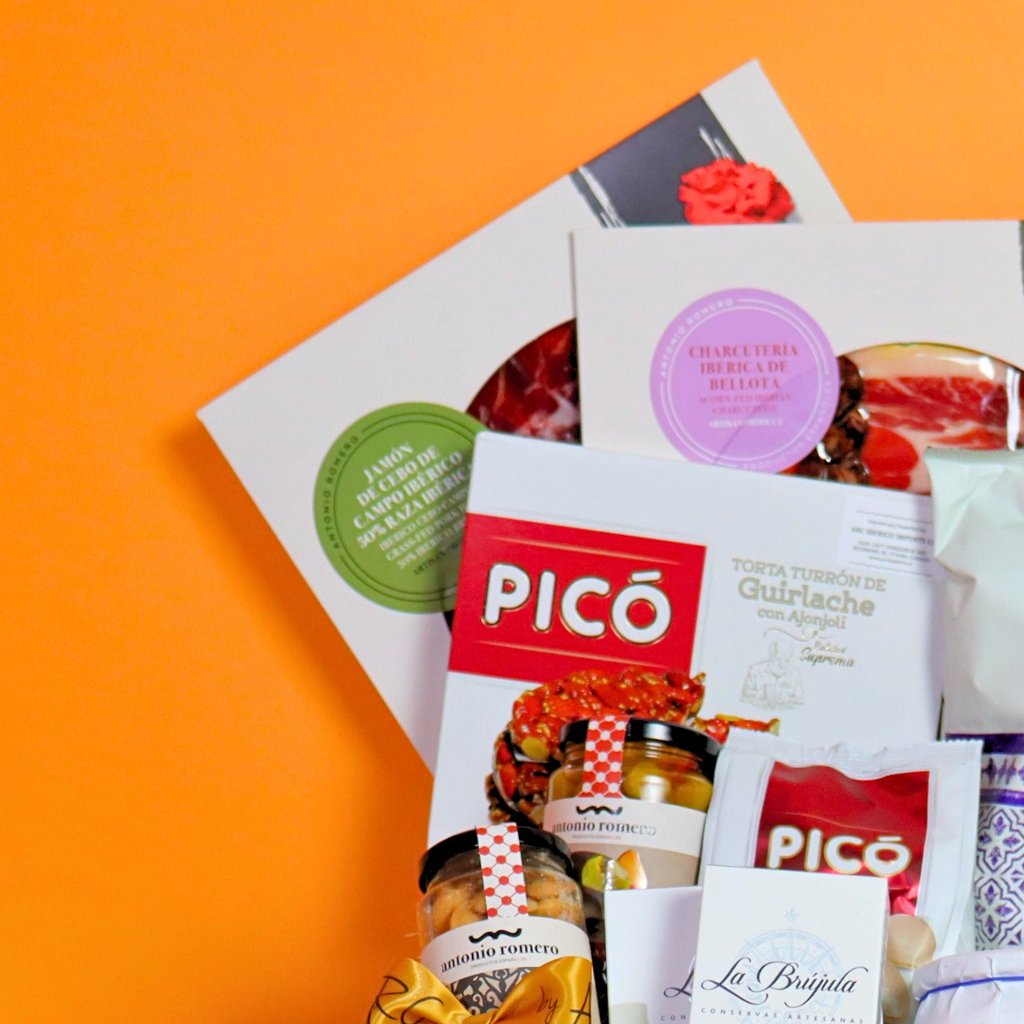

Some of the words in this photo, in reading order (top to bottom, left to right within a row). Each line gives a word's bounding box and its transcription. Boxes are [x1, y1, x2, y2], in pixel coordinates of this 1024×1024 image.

[710, 377, 782, 391] BELLOTA
[768, 360, 788, 373] DE
[356, 484, 381, 507] DE
[378, 460, 420, 493] CEBO
[415, 446, 440, 468] DE
[364, 441, 414, 484] JAMÓN
[353, 490, 405, 530] CAMPO
[356, 522, 388, 549] 50%
[384, 498, 425, 530] RAZA
[732, 557, 787, 578] TORTA
[790, 565, 861, 589] TURRÓN
[864, 577, 887, 592] DE
[481, 562, 672, 645] PICÓ
[738, 576, 876, 617] Guirlache
[757, 607, 785, 621] con
[766, 824, 912, 877] PICÓ
[440, 945, 496, 973] antonio
[500, 943, 559, 956] romero
[701, 956, 769, 1005] La
[748, 960, 869, 1008] Brújula
[537, 986, 560, 1024] by
[701, 1007, 778, 1019] CONSERVAS
[787, 1014, 865, 1024] ARTESANAS
